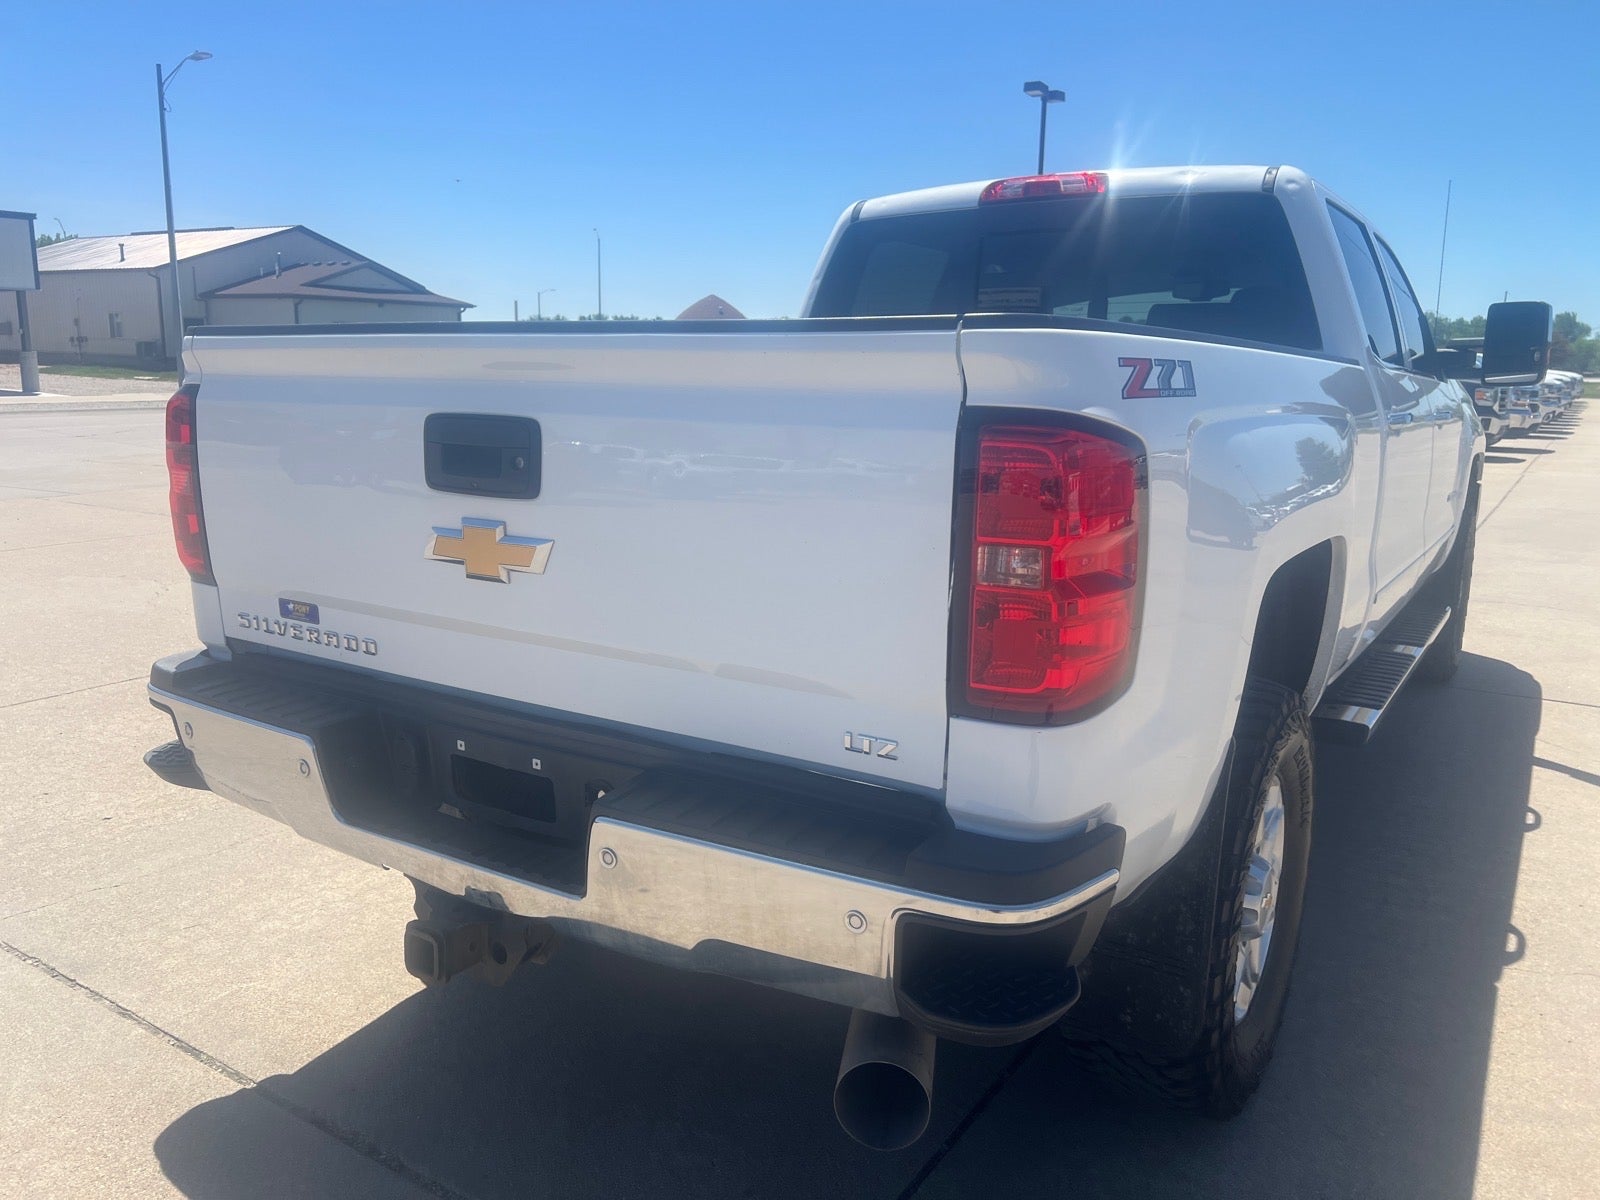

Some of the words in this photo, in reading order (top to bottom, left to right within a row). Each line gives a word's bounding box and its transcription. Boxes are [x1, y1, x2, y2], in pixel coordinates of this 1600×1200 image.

[1118, 357, 1196, 399] Z71
[237, 611, 378, 656] SILVERADO
[844, 731, 899, 761] LTZ
